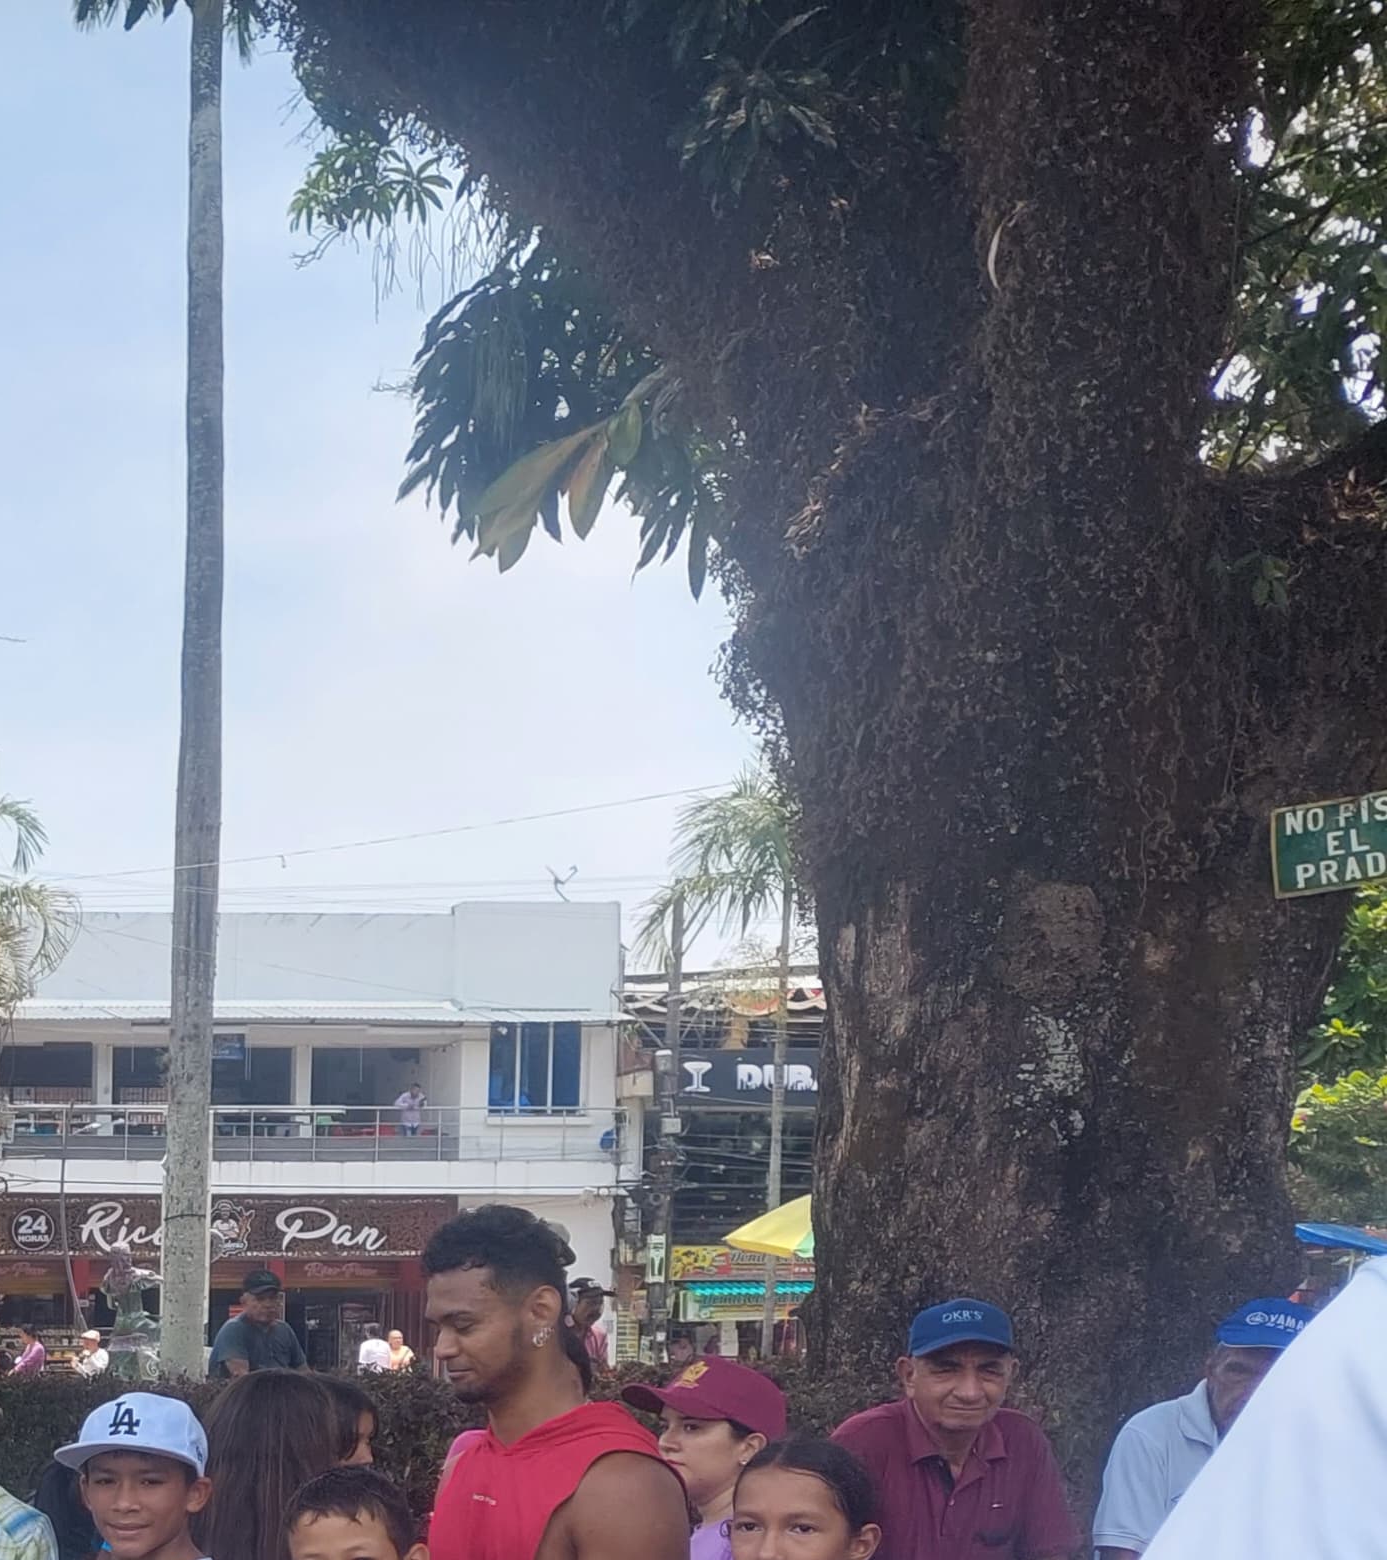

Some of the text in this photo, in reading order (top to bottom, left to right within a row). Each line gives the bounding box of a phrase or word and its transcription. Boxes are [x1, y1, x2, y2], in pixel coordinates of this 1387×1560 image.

[1285, 806, 1324, 836] NO
[1327, 828, 1371, 857] EL
[17, 1215, 48, 1235] 24
[276, 1207, 388, 1252] Pan
[108, 1400, 141, 1436] LA
